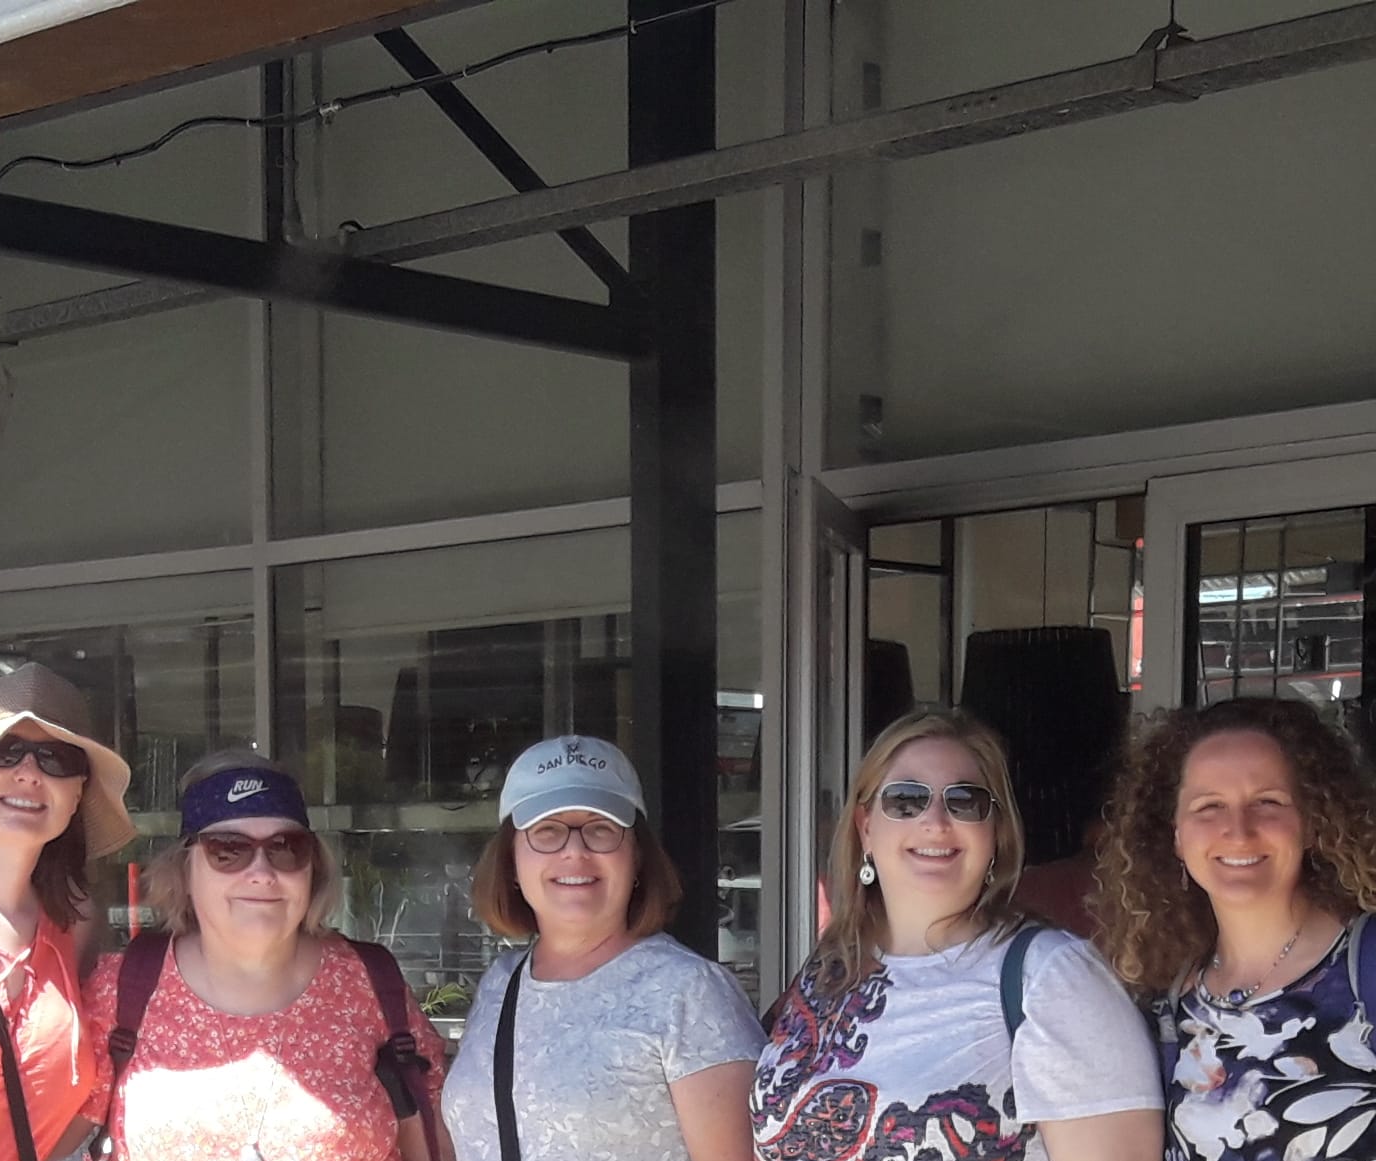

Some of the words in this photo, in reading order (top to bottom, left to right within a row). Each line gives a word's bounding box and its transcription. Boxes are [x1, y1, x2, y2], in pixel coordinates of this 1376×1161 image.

[536, 755, 563, 775] SAN
[566, 754, 607, 771] DIEGO
[233, 779, 264, 797] RUN
